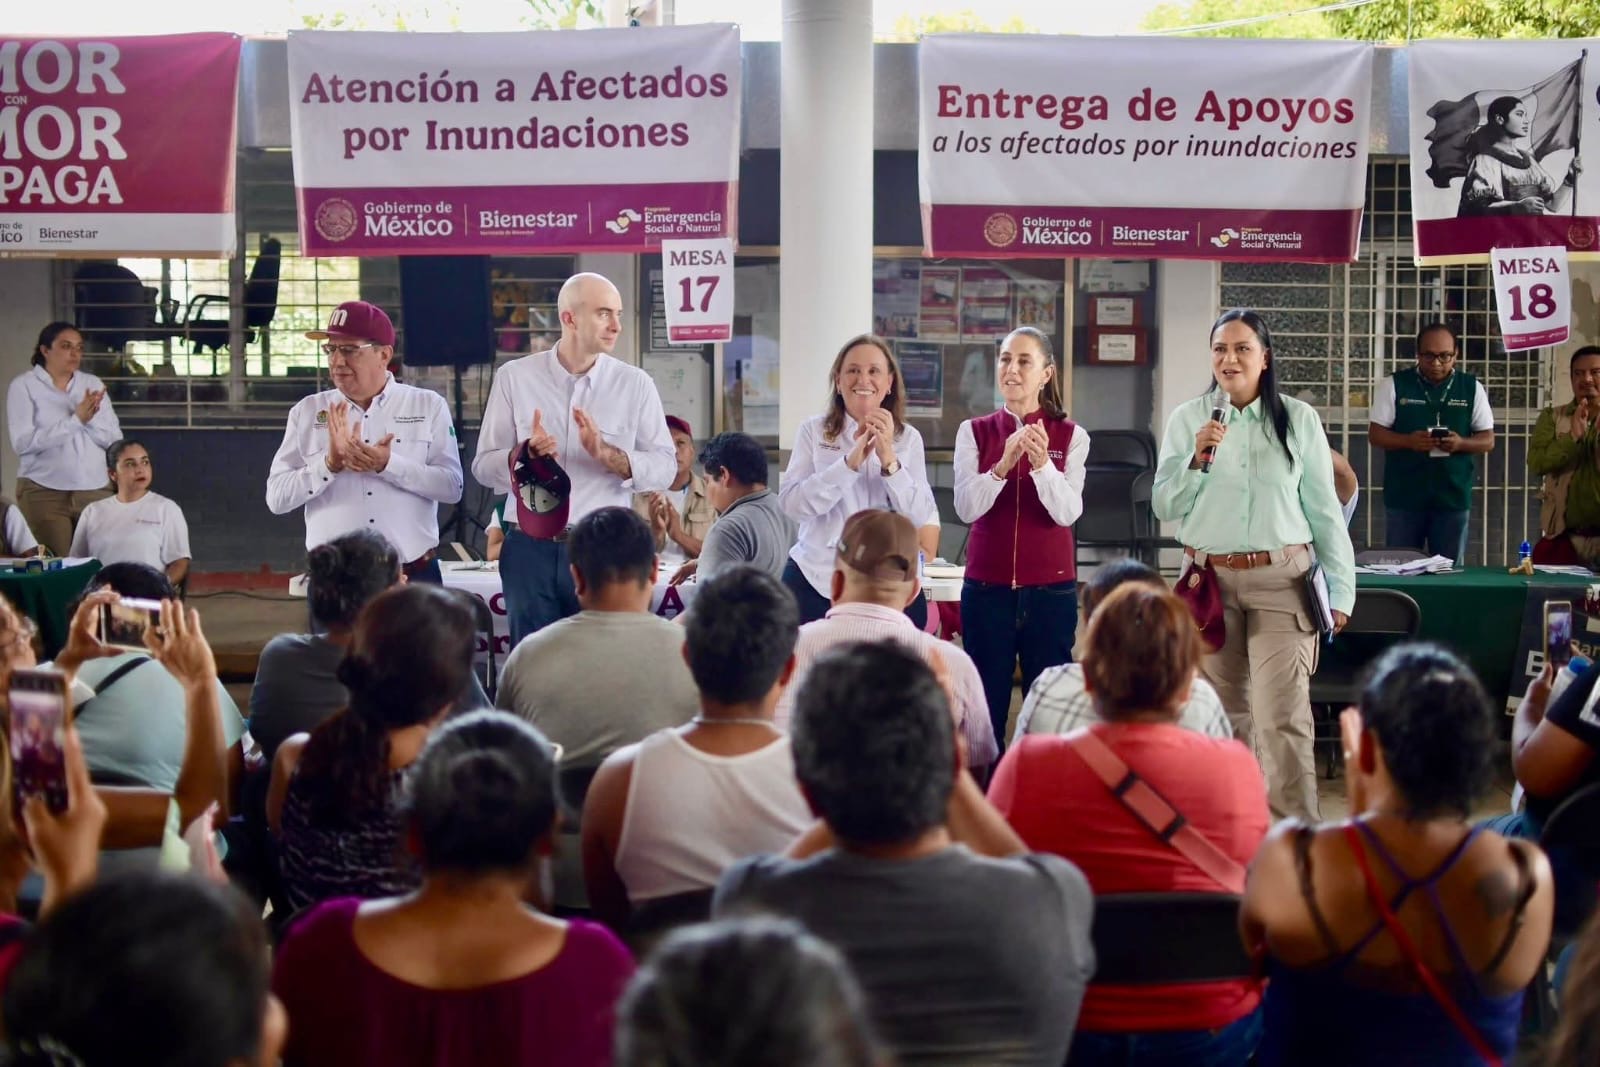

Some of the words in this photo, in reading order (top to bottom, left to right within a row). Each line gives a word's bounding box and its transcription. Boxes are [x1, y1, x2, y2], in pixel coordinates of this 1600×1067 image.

[302, 70, 479, 104] Atención
[495, 79, 515, 102] a
[531, 65, 729, 102] Afectados
[5, 95, 27, 105] CON
[937, 84, 1109, 131] Entrega
[1128, 87, 1177, 122] de
[1195, 90, 1354, 133] Apoyos
[343, 126, 409, 159] por
[426, 117, 690, 151] Inundaciones
[932, 134, 948, 153] a
[955, 130, 992, 153] los
[1000, 130, 1126, 160] afectados
[1133, 137, 1179, 161] por
[1186, 134, 1357, 160] inundaciones
[364, 201, 432, 214] Gobierno
[435, 201, 453, 214] de
[364, 214, 453, 236] México
[479, 210, 578, 228] Bienestar
[644, 210, 721, 226] Emergencia
[1022, 216, 1076, 227] Gobierno
[1078, 217, 1093, 227] de
[39, 227, 99, 240] Bienestar
[644, 224, 674, 233] Social
[676, 225, 683, 233] o
[685, 223, 721, 233] Natural
[1022, 226, 1093, 245] México
[1112, 226, 1190, 241] Bienestar
[1241, 231, 1302, 243] Emergencia
[1241, 241, 1264, 249] Social
[1273, 241, 1302, 249] Natural
[669, 250, 727, 266] MESA
[1498, 257, 1561, 275] MESA
[678, 275, 721, 313] 17
[1507, 282, 1557, 321] 18
